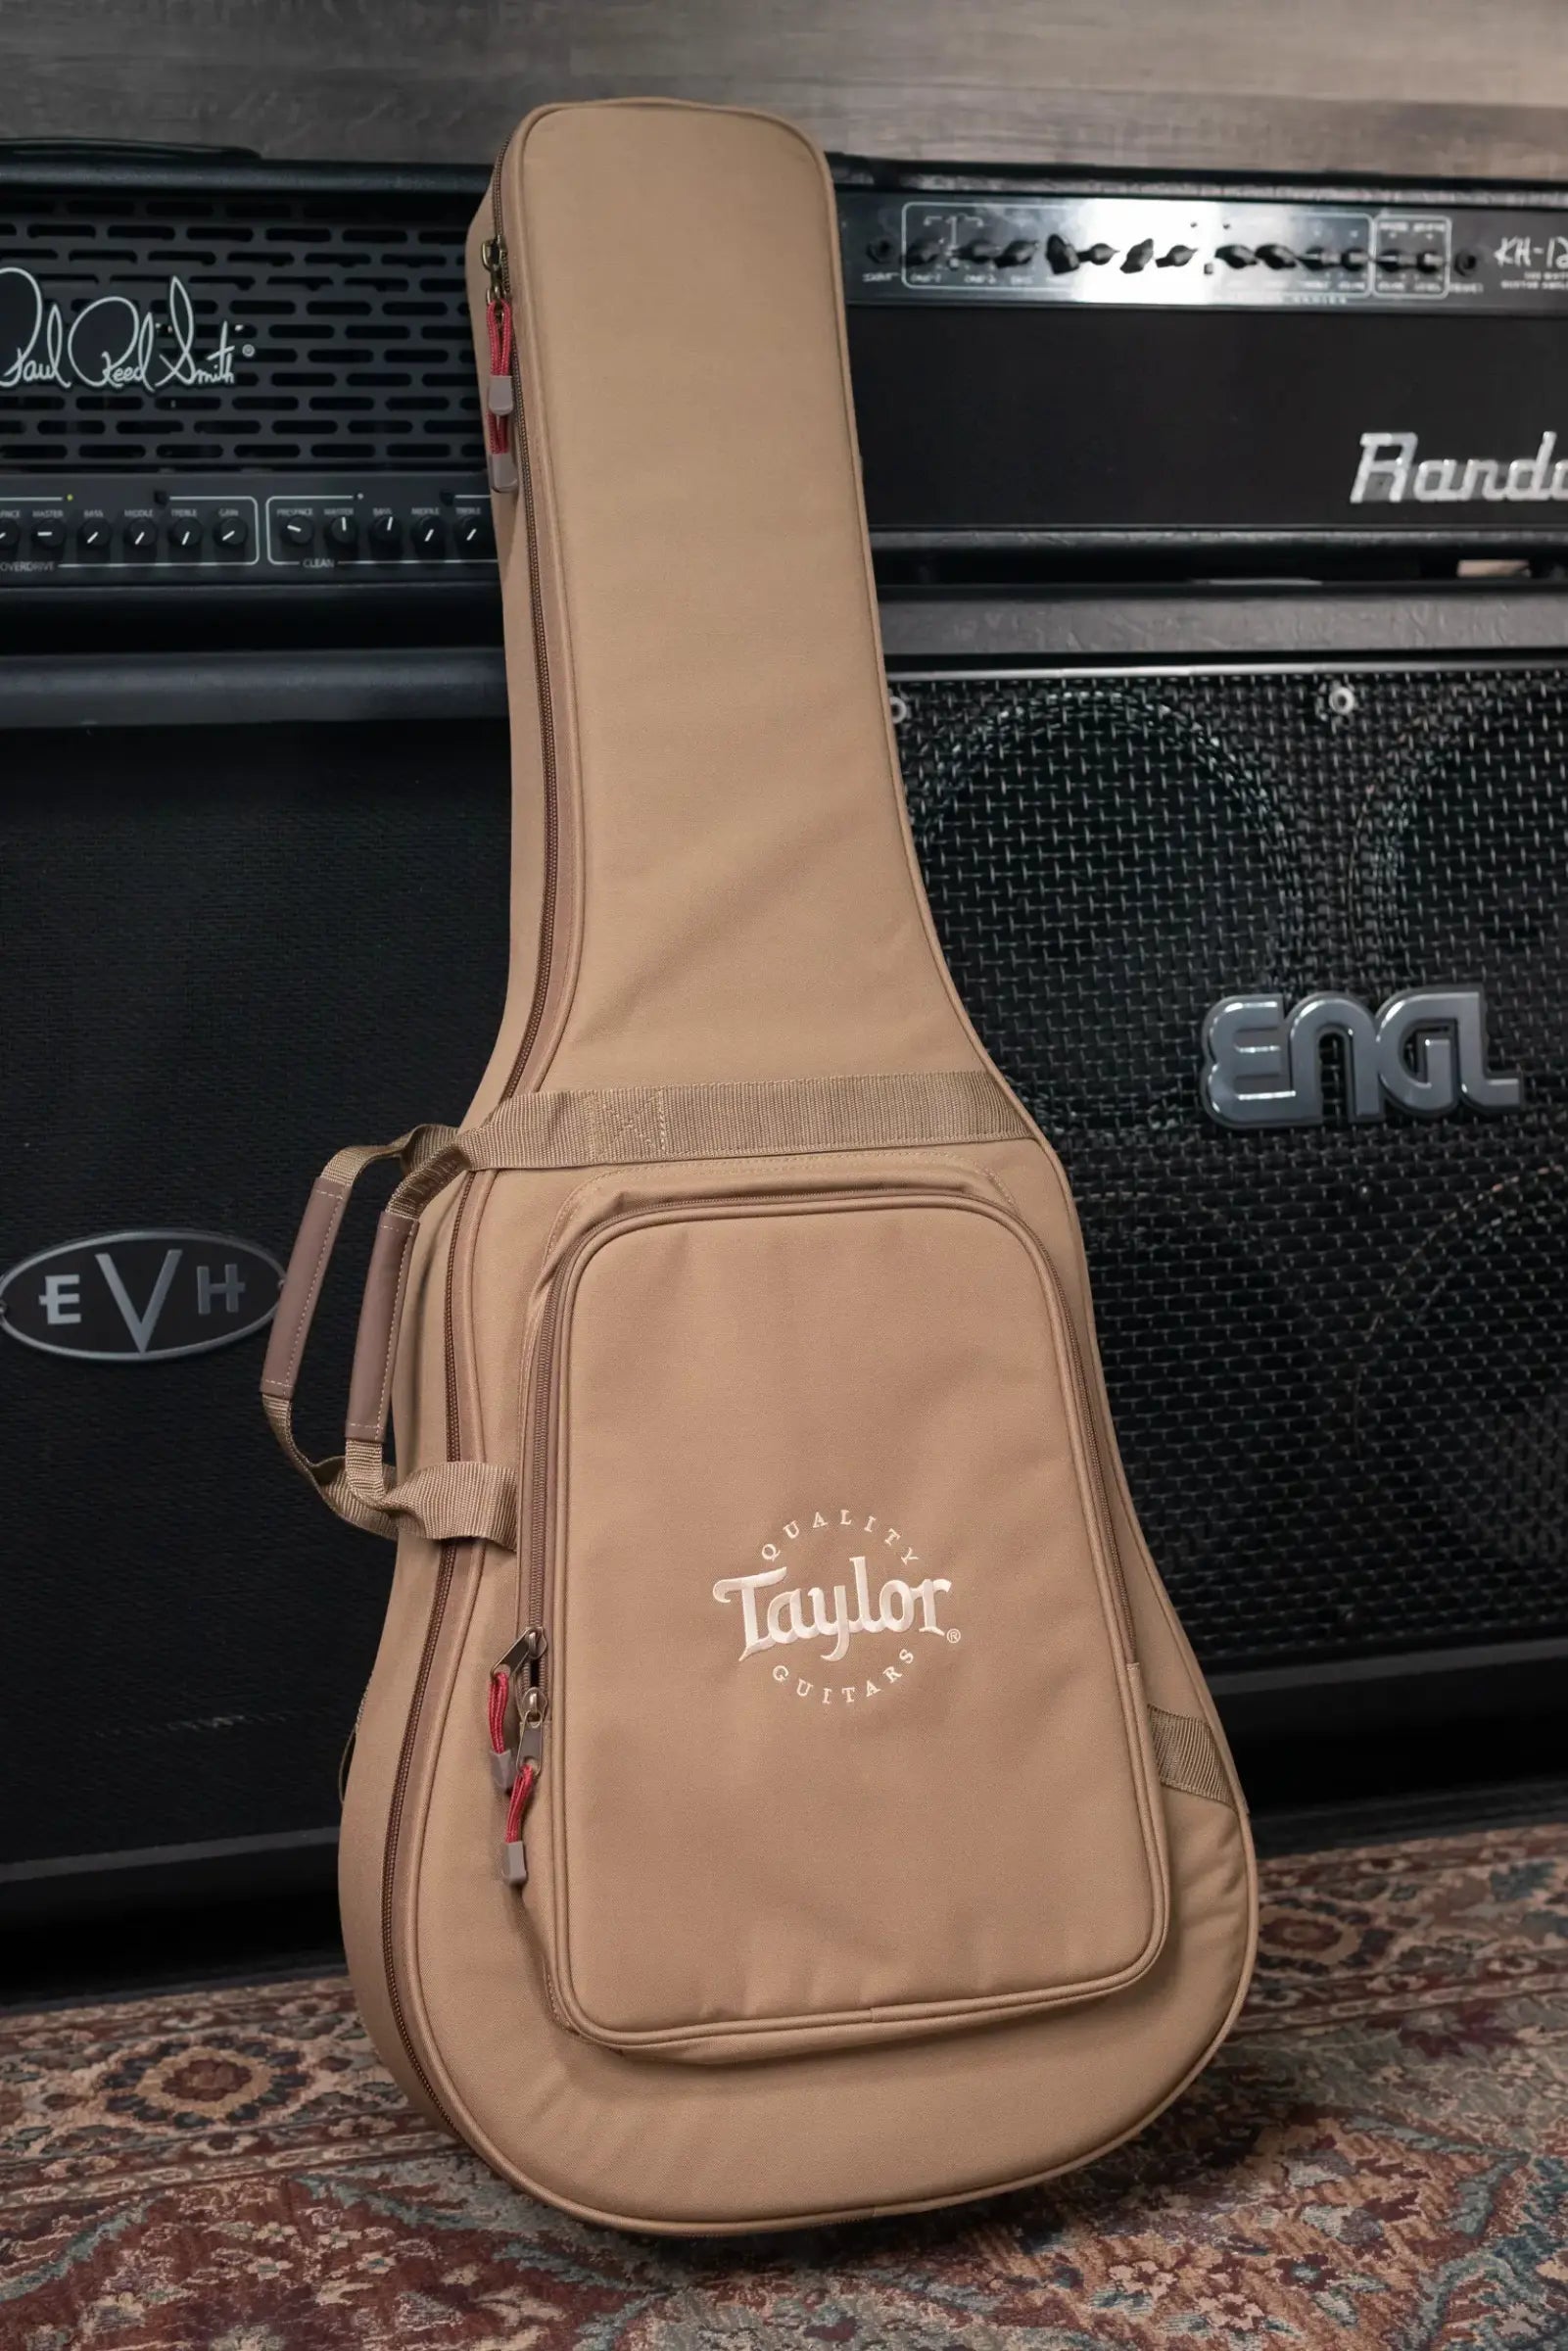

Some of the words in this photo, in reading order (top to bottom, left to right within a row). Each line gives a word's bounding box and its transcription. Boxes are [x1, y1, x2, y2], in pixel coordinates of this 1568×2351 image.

[68, 296, 155, 392] Reed
[154, 275, 236, 386] Smith
[32, 509, 63, 518] MASTER
[84, 509, 103, 518] BASS
[124, 508, 153, 517] MIDDLE
[171, 507, 197, 517] TREBLE
[218, 507, 239, 517] GAIN
[325, 507, 354, 516] MASTER
[455, 506, 481, 516] TREBLE
[303, 558, 335, 568] CLEAN
[1203, 984, 1521, 1128] ENGL
[38, 1248, 245, 1357] EVH
[761, 1509, 919, 1565] QUALITY
[712, 1556, 952, 1662] Taylor
[772, 1648, 914, 1704] GUITARS
